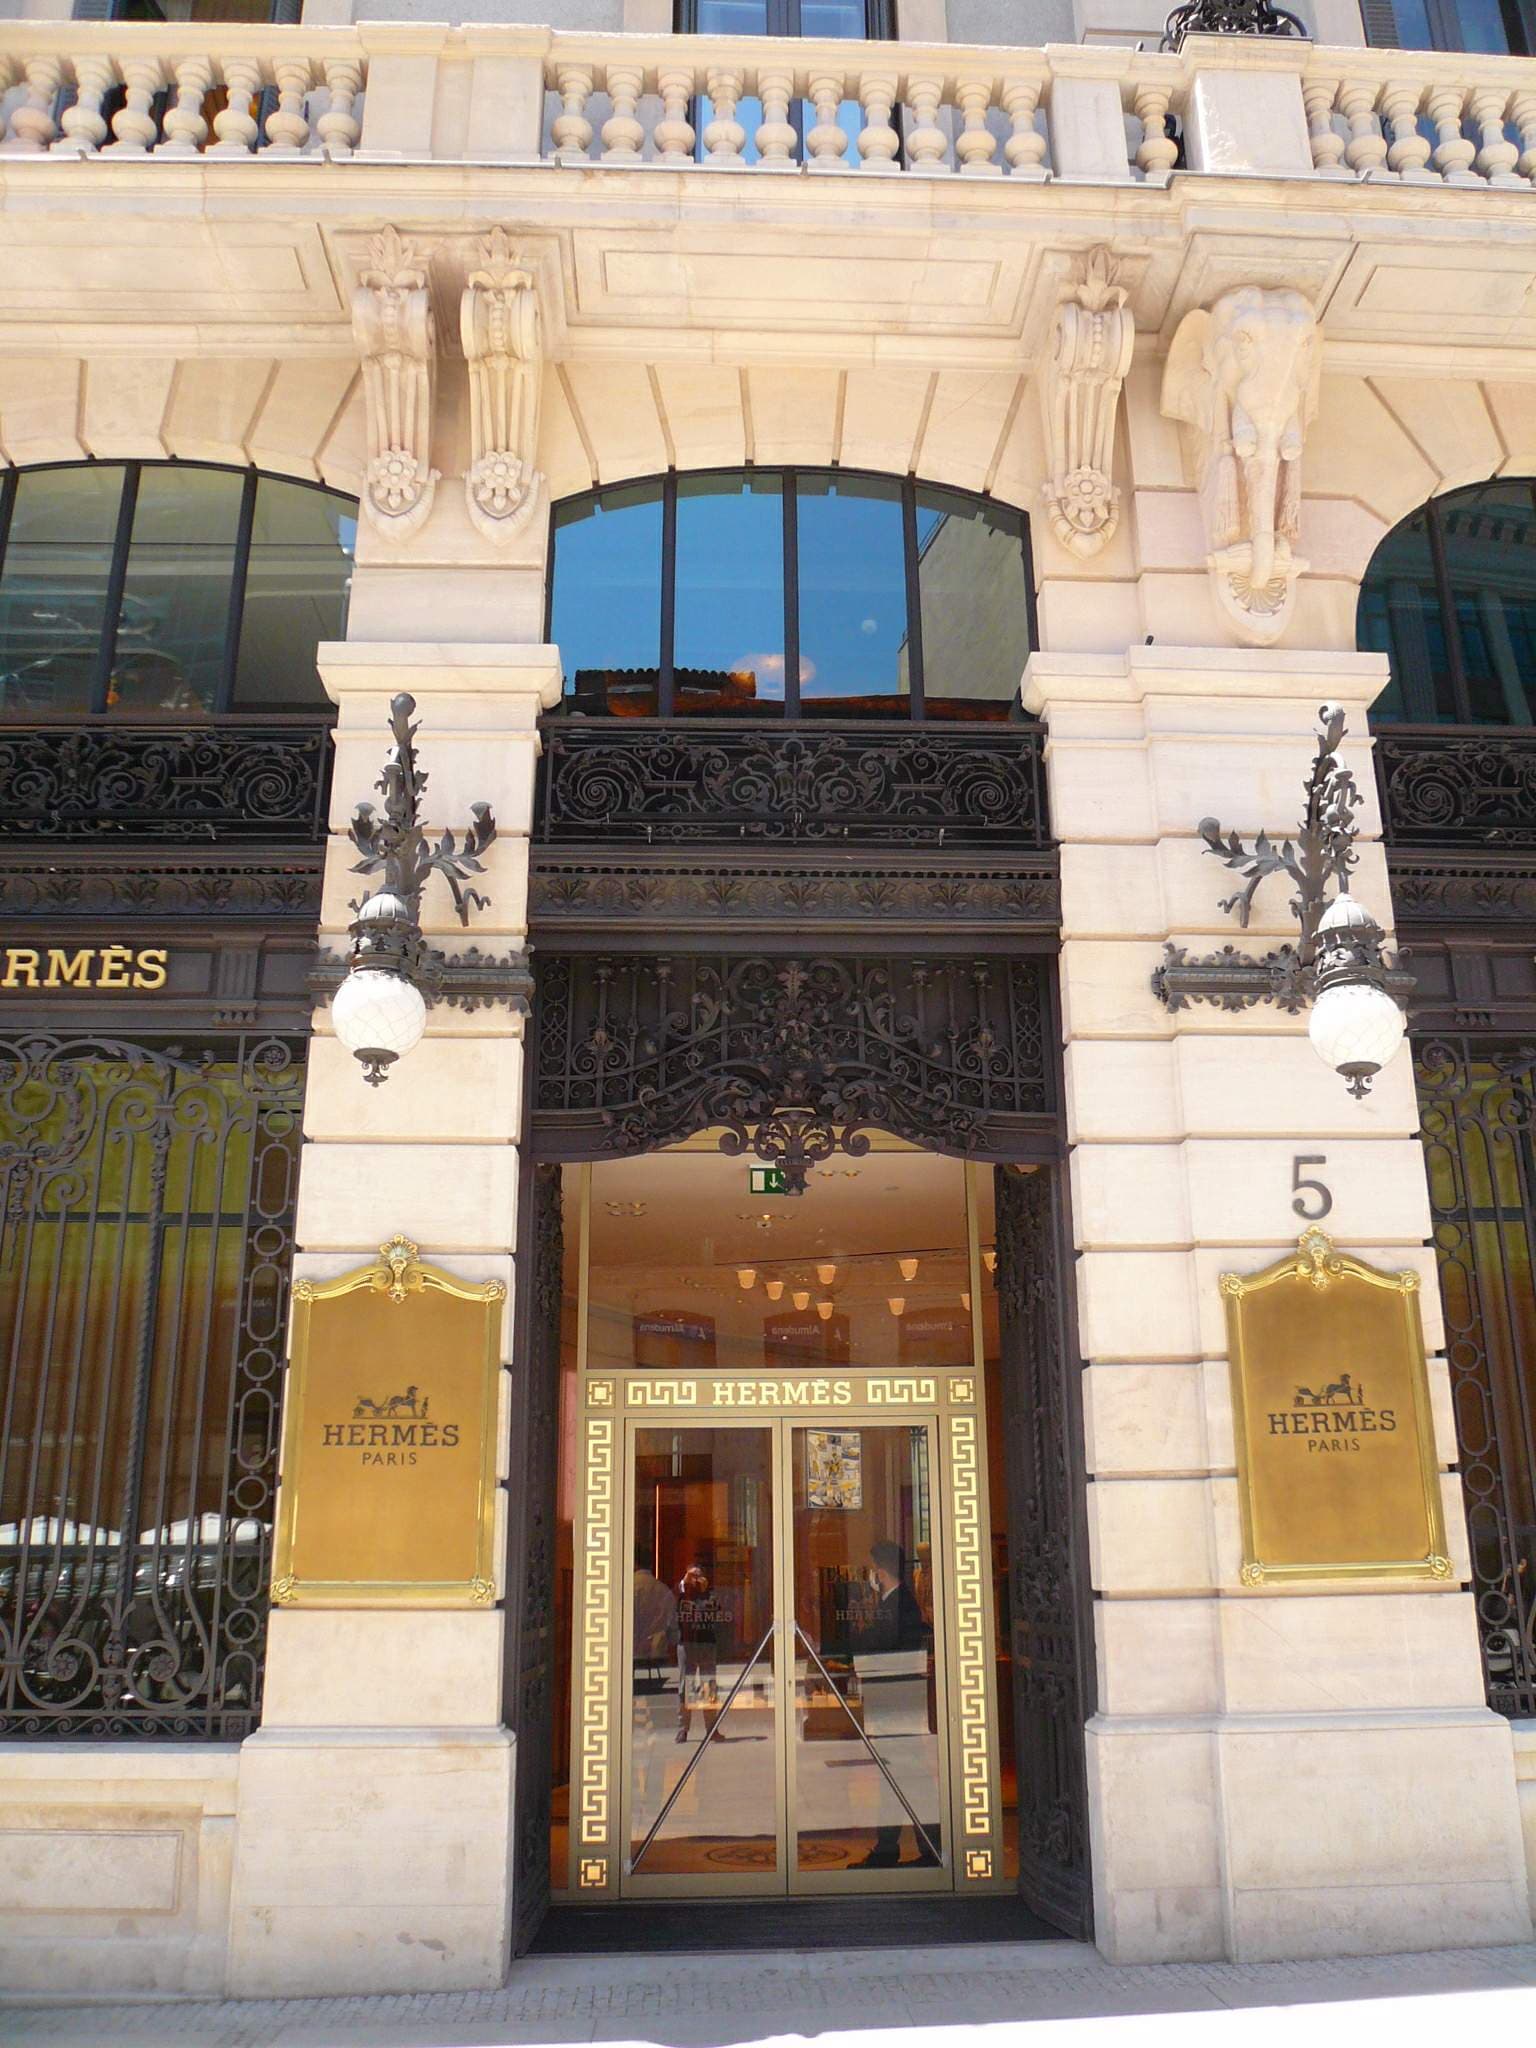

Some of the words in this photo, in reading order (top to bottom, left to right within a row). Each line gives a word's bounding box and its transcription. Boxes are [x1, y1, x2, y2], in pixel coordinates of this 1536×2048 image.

[1, 945, 168, 989] RMÈS
[1291, 1155, 1333, 1220] 5
[712, 1379, 852, 1405] HERMÈS
[1267, 1407, 1397, 1435] HERMÈS
[322, 1422, 460, 1447] HERMÈS
[1308, 1438, 1360, 1453] PARIS
[362, 1451, 418, 1466] PARIS
